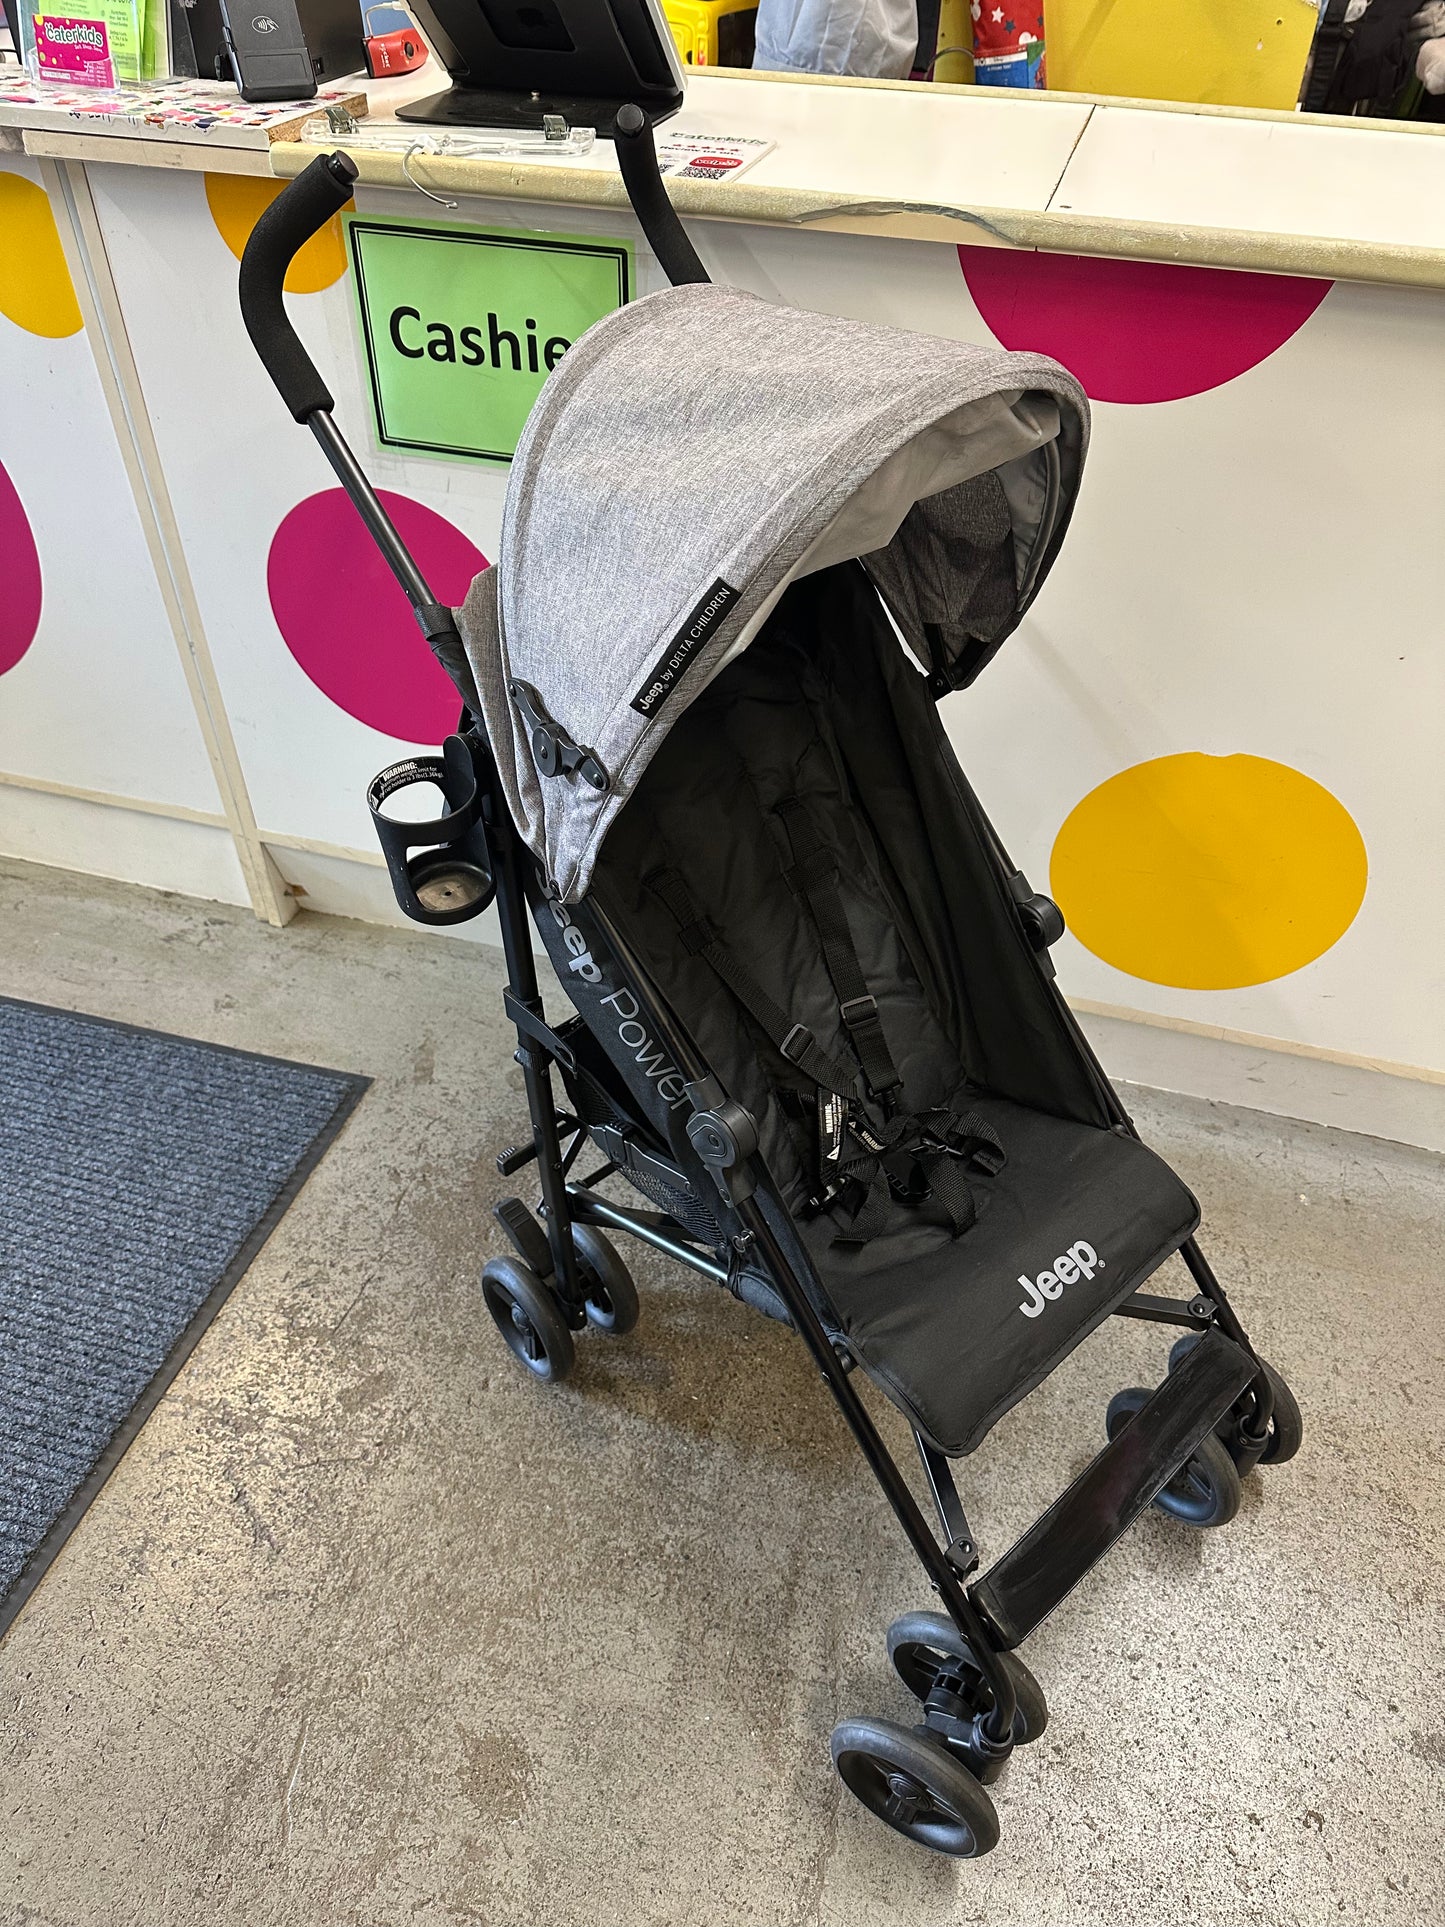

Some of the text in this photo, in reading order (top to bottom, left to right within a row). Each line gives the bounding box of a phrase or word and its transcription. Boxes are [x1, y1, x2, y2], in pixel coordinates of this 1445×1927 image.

[388, 305, 572, 373] Cashie
[660, 669, 675, 681] by
[669, 639, 695, 669] DELTA
[690, 587, 731, 638] CHILDREN
[382, 762, 418, 782] WARNING:
